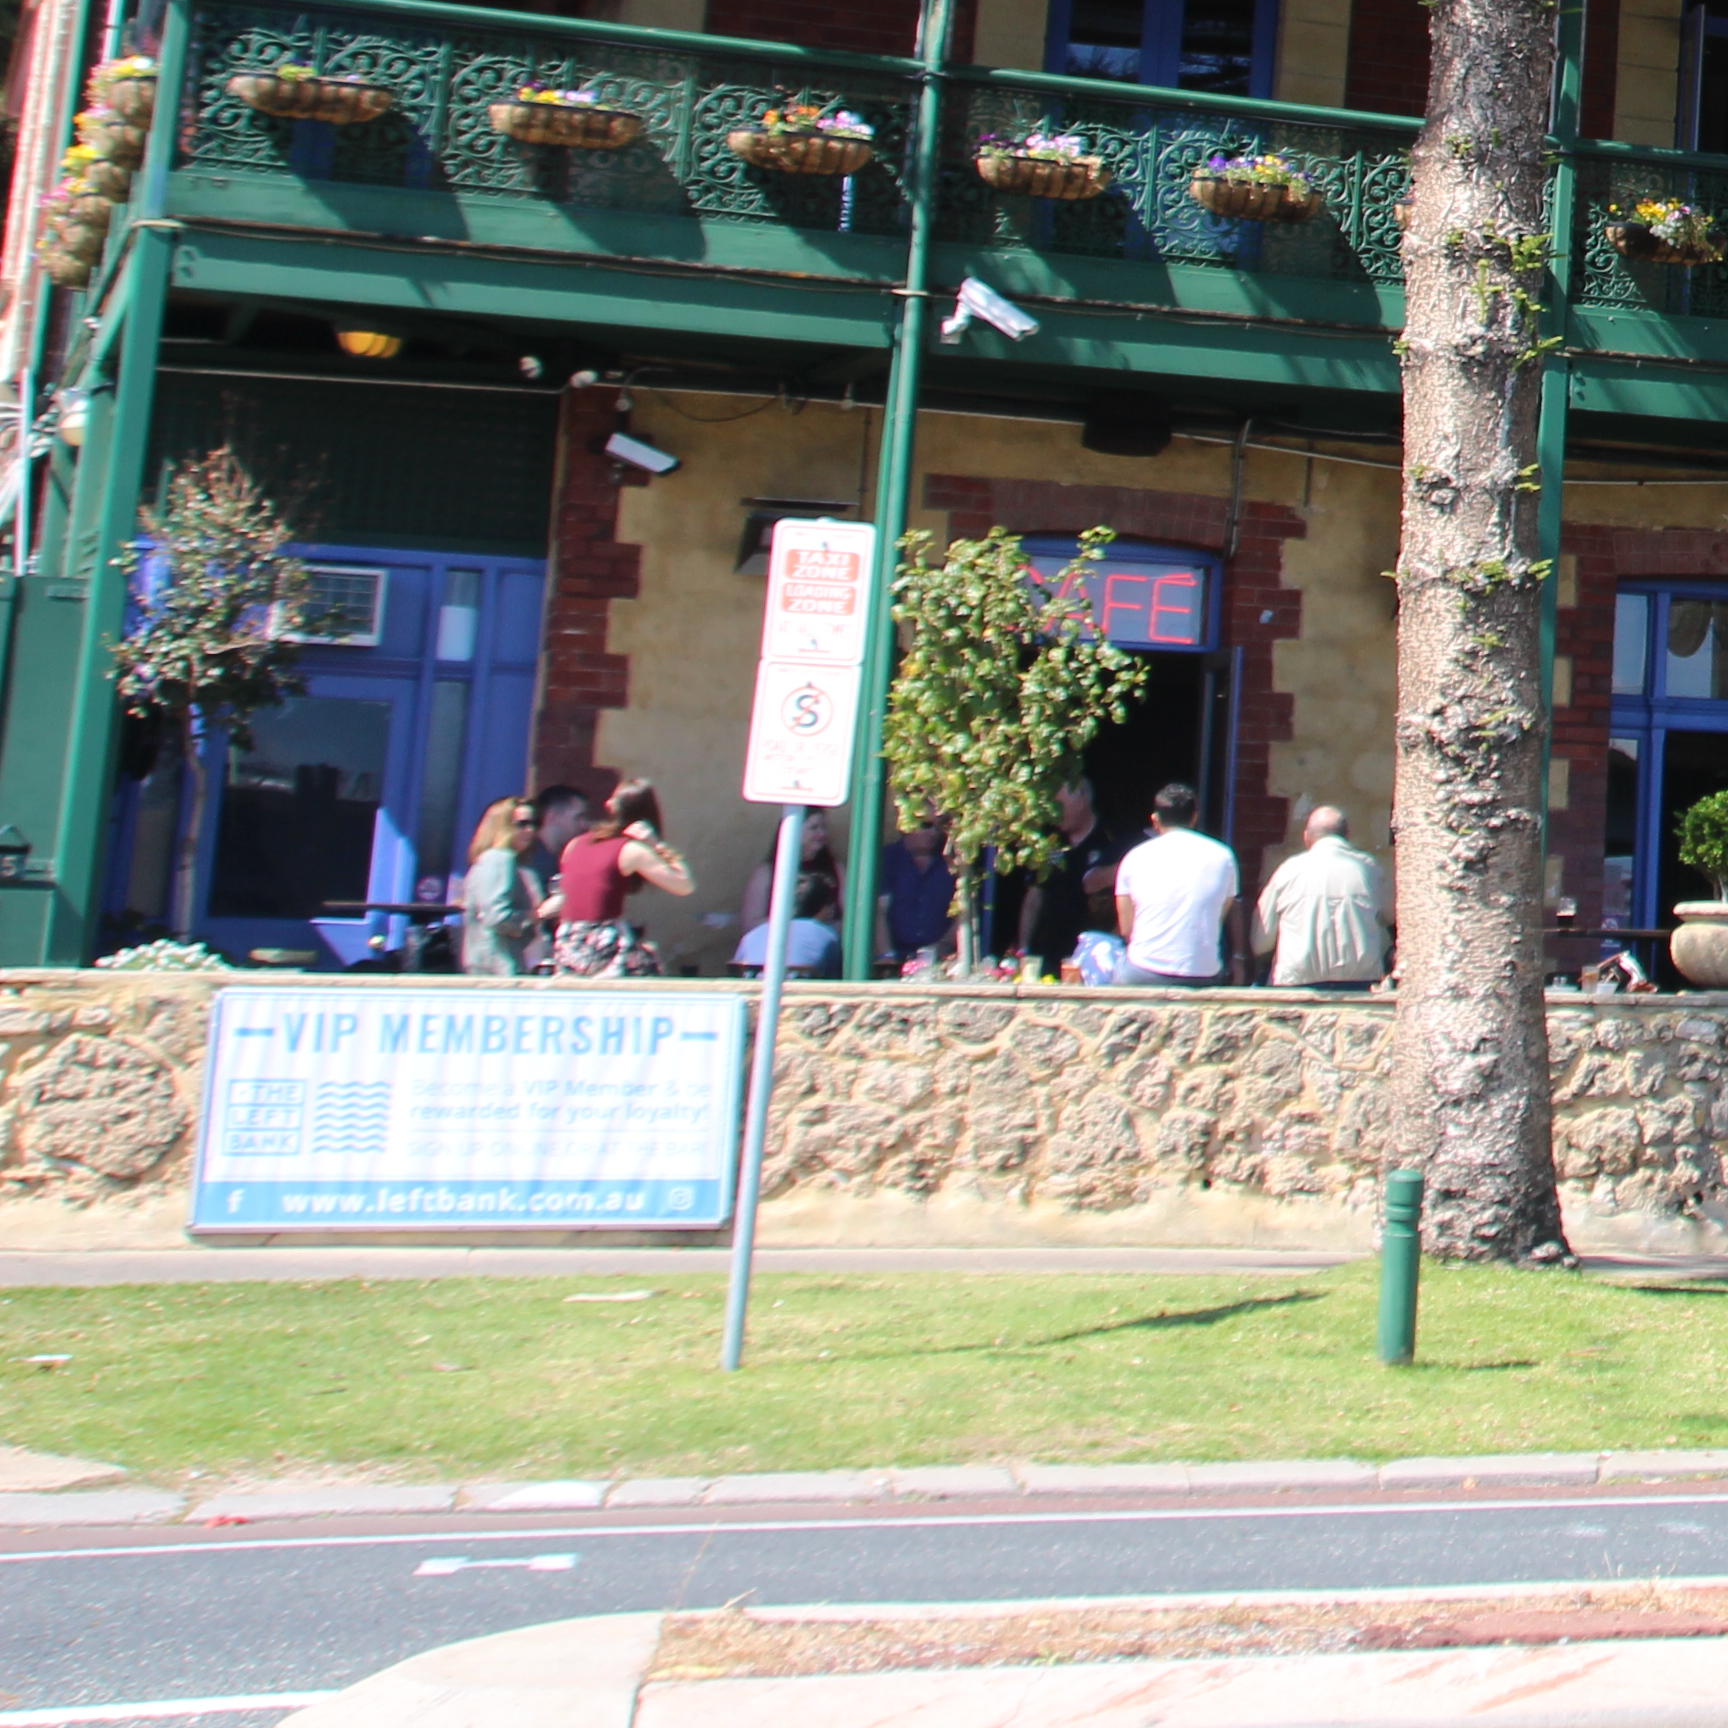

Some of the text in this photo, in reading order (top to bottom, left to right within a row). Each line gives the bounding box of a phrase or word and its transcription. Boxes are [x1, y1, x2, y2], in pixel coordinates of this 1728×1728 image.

[797, 551, 850, 566] TAXI
[792, 565, 850, 580] ZONE
[786, 584, 850, 600] LOADING
[788, 599, 847, 614] ZONE
[283, 1012, 674, 1057] VIP MEMBERSHIP
[252, 1084, 298, 1102] THE
[411, 1079, 499, 1097] Become
[523, 1080, 558, 1095] VIP
[564, 1079, 657, 1097] Member
[664, 1080, 679, 1097] &
[687, 1081, 710, 1097] be
[231, 1108, 294, 1126] LEFT
[410, 1103, 709, 1124] rewarded for your loyalty!
[228, 1133, 294, 1151] BANK
[283, 1188, 644, 1214] www.leftbank.com.au
